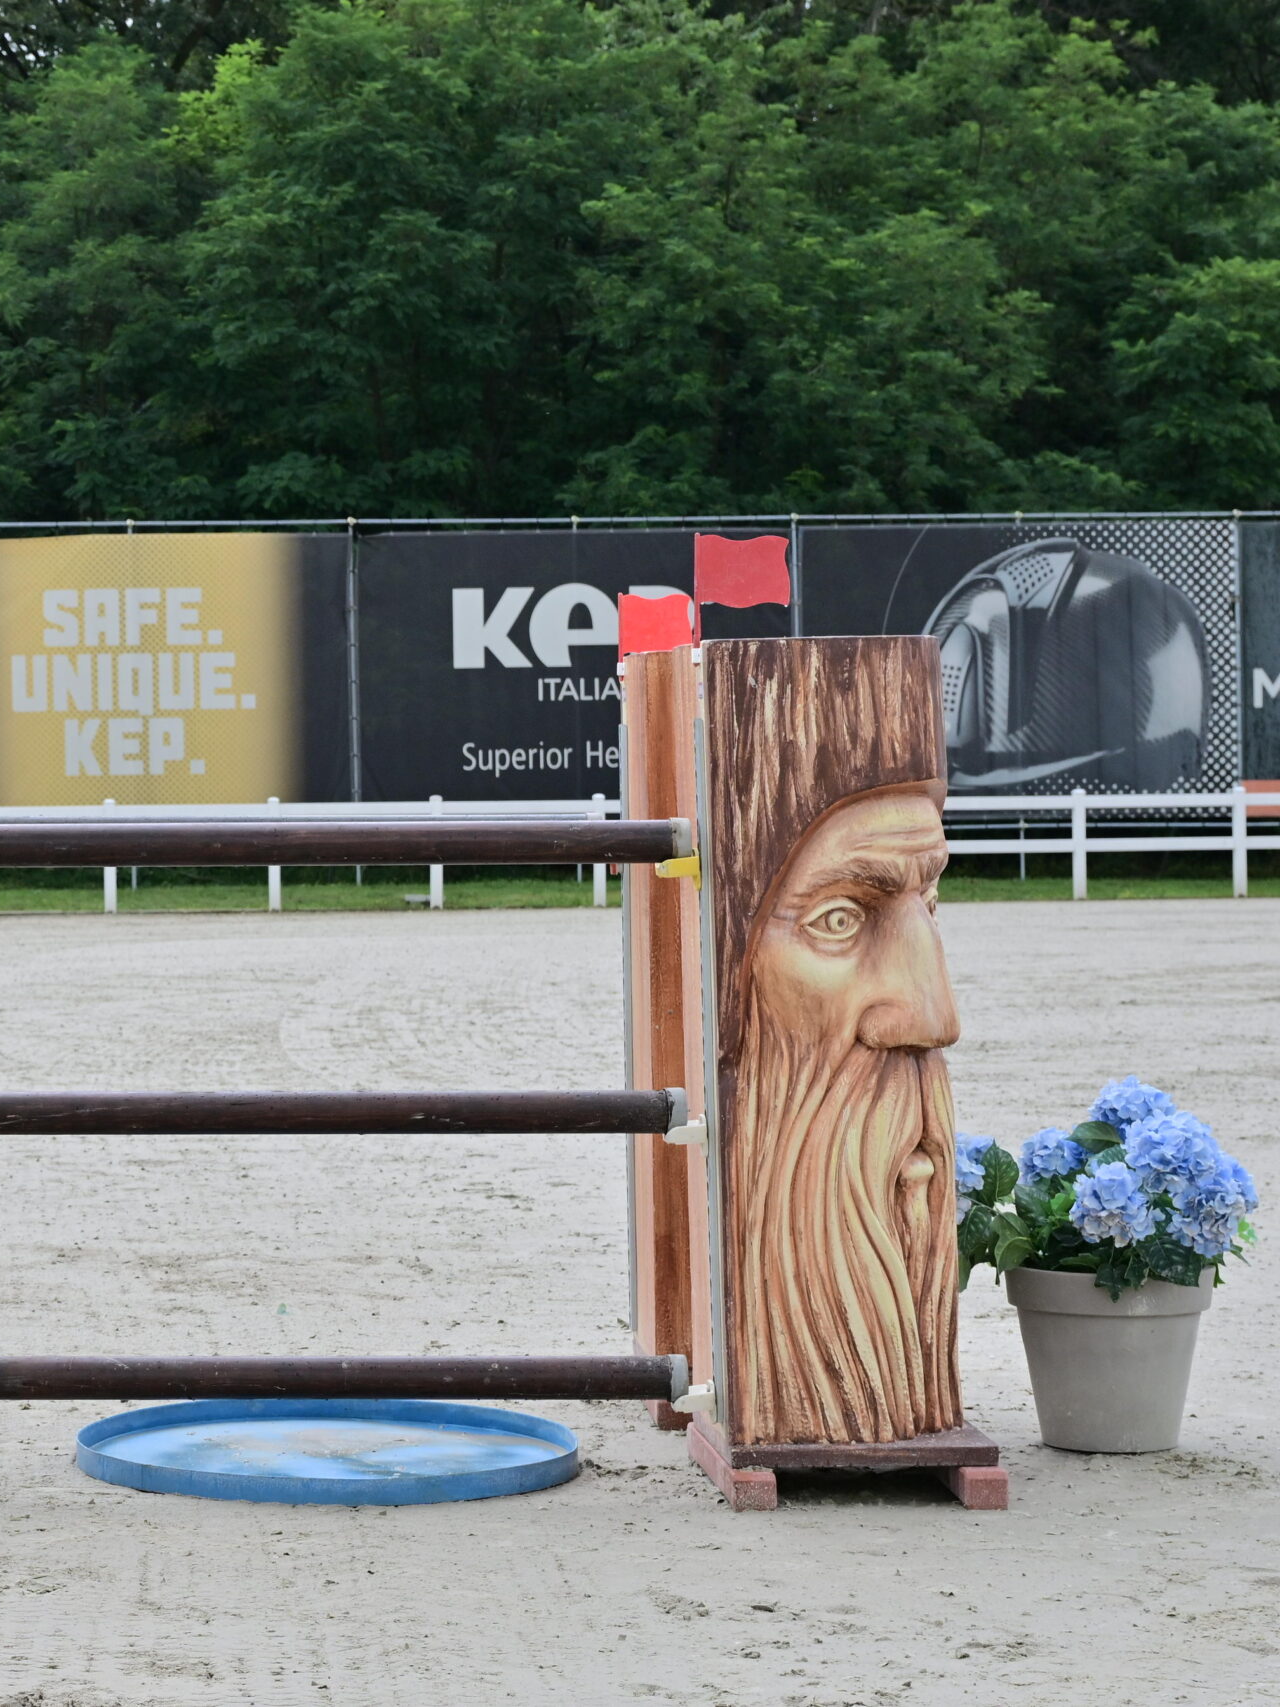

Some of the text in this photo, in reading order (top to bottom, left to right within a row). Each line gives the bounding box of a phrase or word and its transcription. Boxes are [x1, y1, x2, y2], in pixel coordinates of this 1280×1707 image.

[43, 587, 223, 646] SAFE.
[11, 652, 256, 716] UNIQUE.
[538, 677, 621, 701] ITALIA
[64, 717, 206, 777] KEP.
[462, 741, 573, 778] Superior
